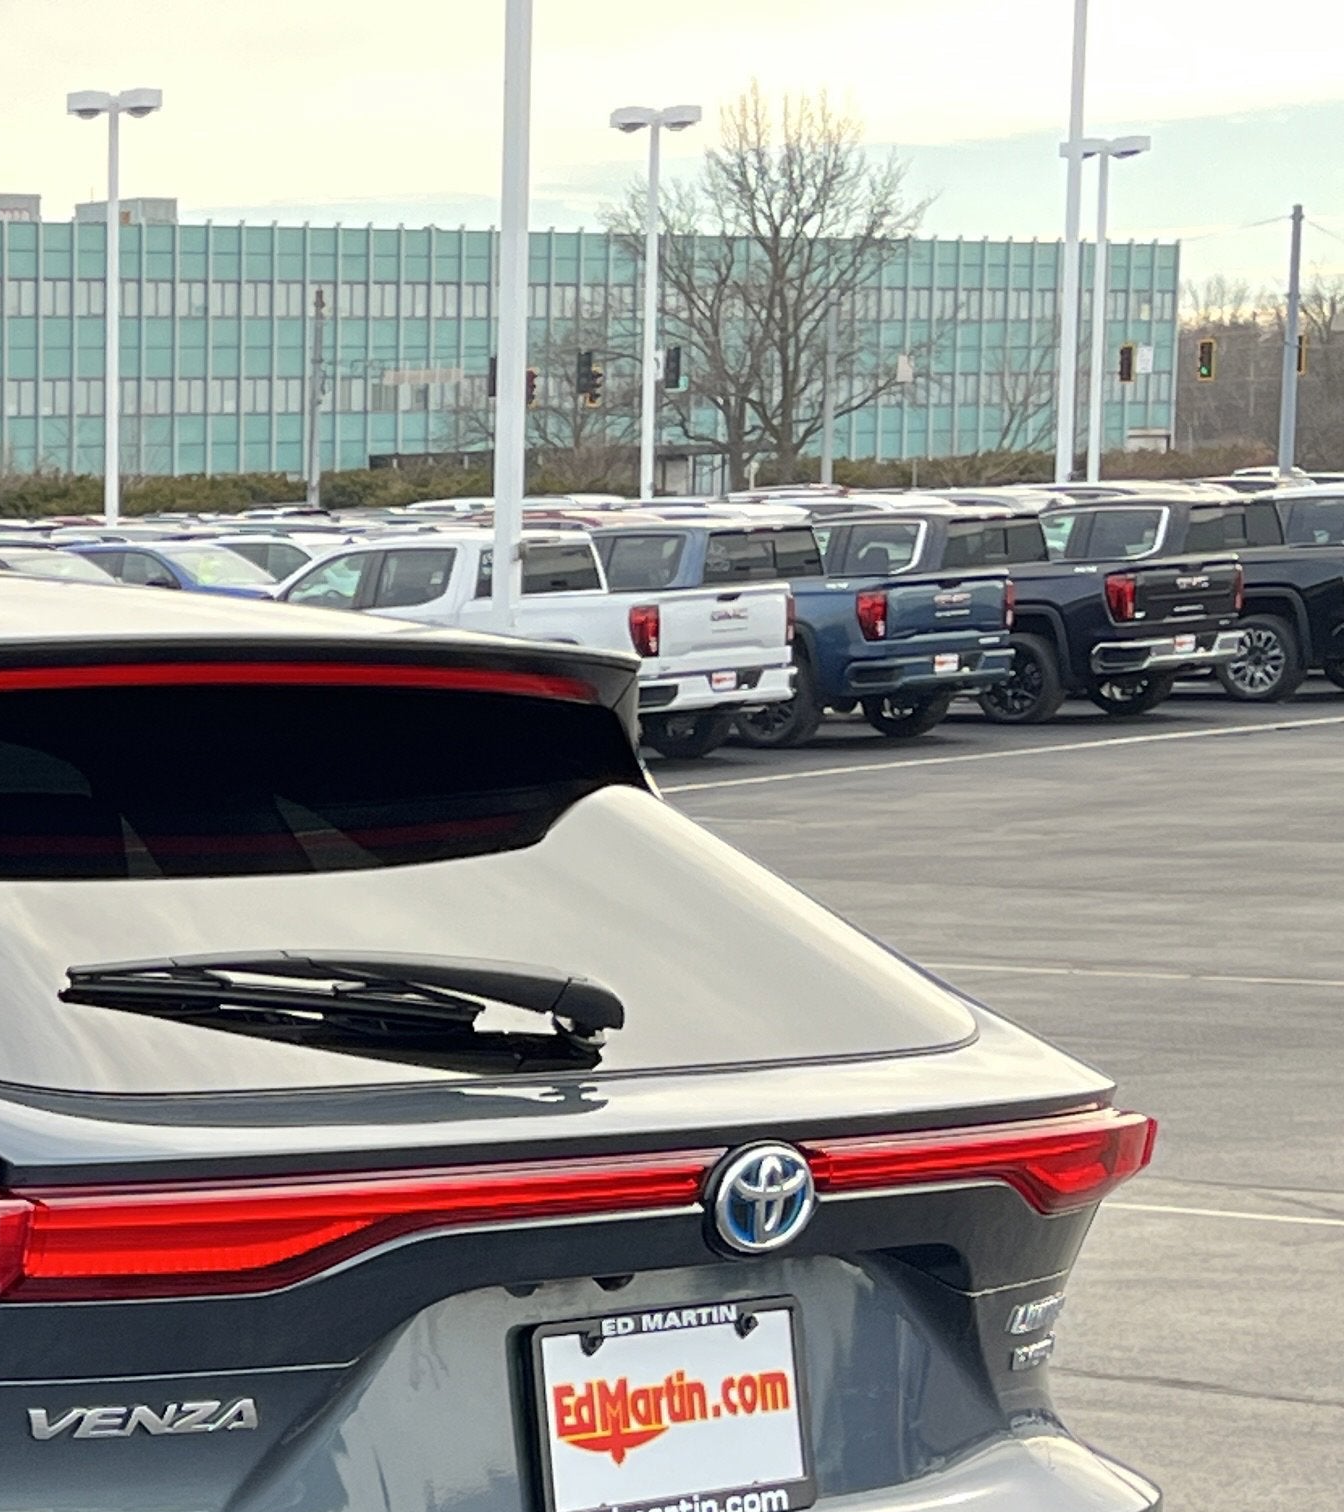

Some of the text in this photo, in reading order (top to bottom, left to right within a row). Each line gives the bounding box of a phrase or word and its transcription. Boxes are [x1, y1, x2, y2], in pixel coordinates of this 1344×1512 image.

[600, 1303, 738, 1337] ED MARTIN
[26, 1397, 259, 1441] VENZA
[551, 1368, 791, 1442] EdMartin.com
